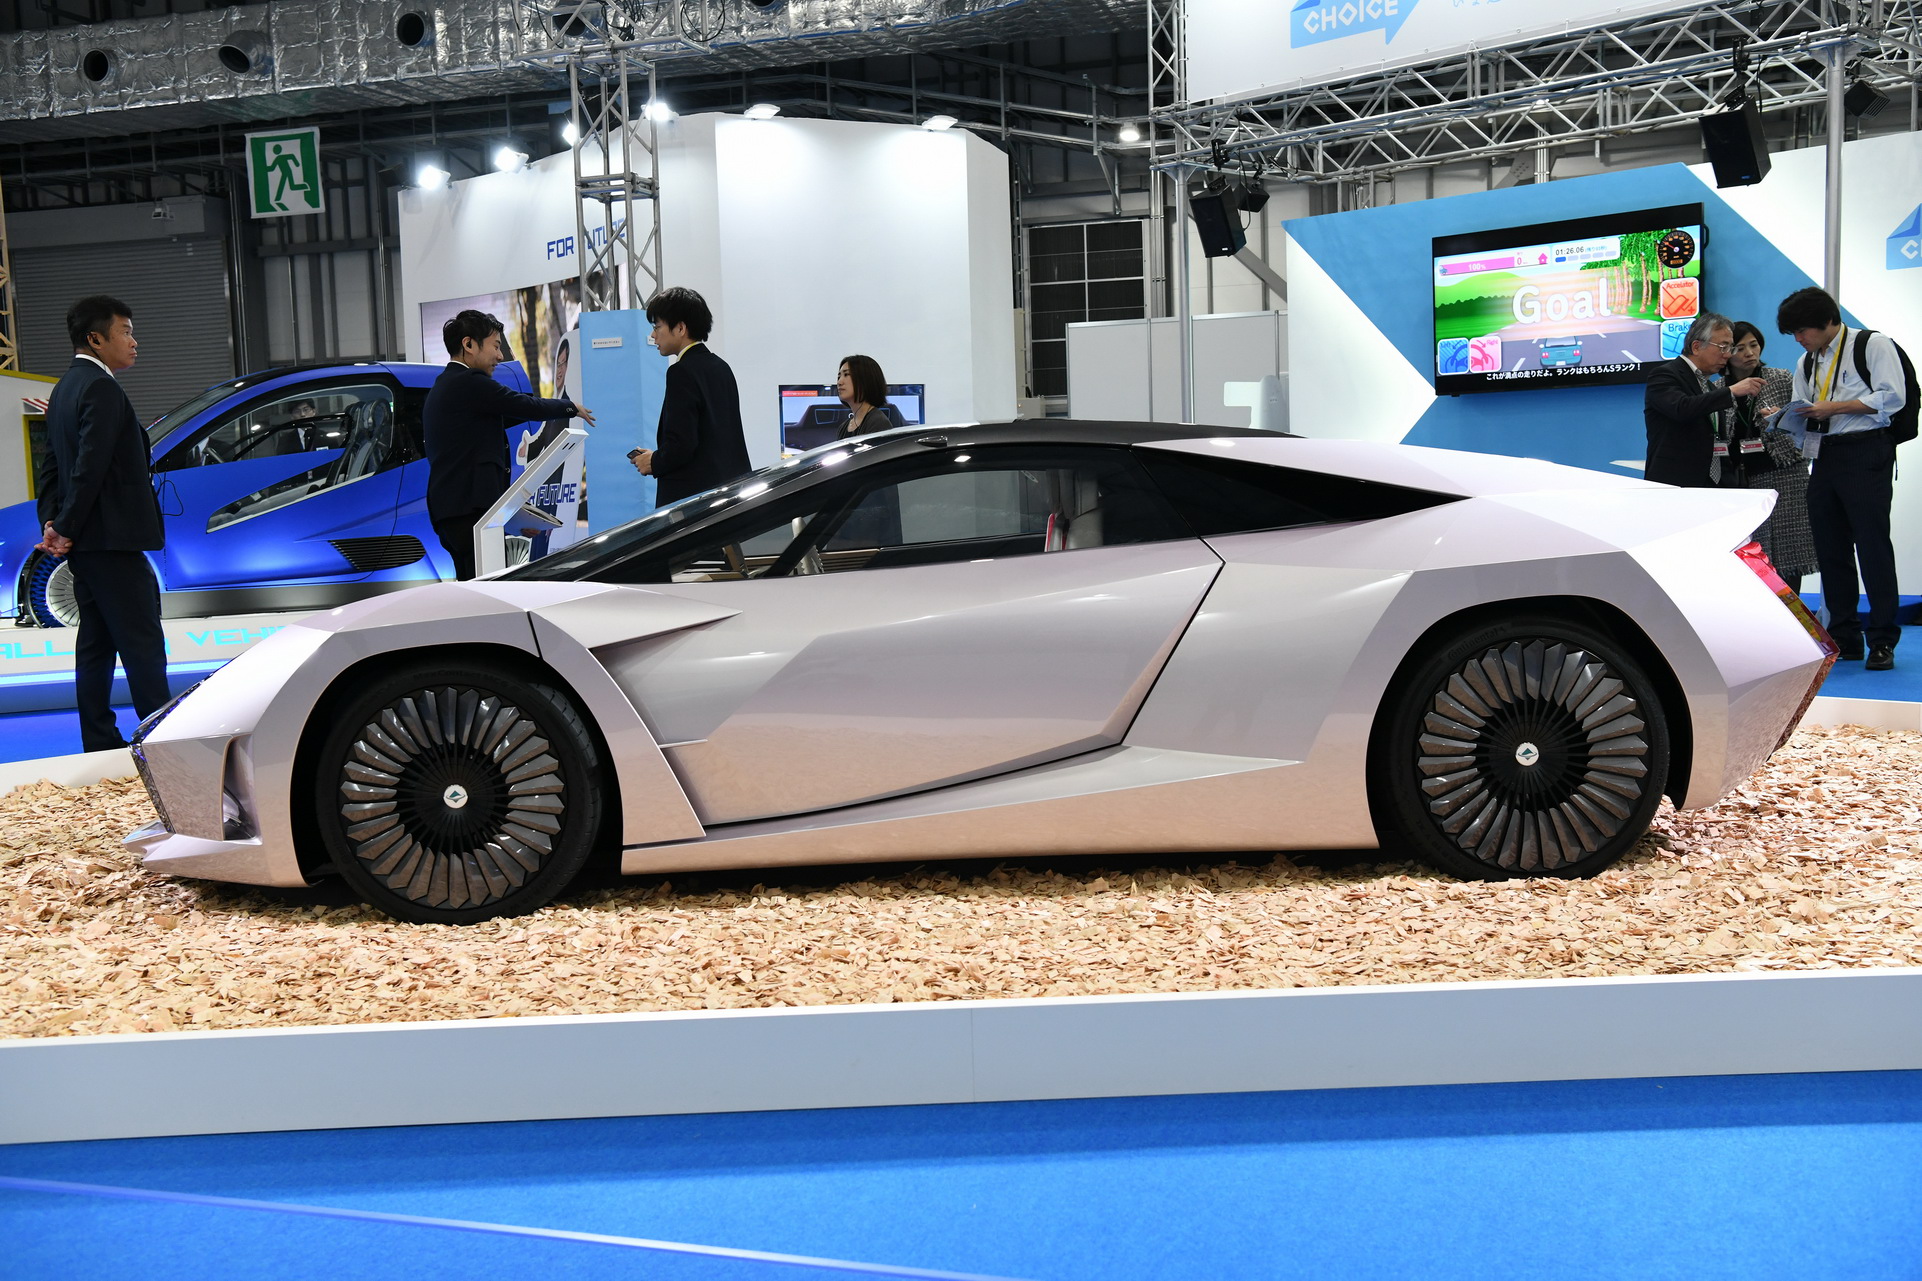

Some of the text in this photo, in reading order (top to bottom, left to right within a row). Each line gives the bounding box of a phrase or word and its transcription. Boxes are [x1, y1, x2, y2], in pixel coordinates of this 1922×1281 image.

[1303, 0, 1398, 34] CHOICE
[547, 236, 574, 260] FOR
[1555, 246, 1584, 256] 01:26.06
[1468, 263, 1486, 271] 100%
[1512, 277, 1612, 324] Goal
[537, 483, 577, 506] FUTURE
